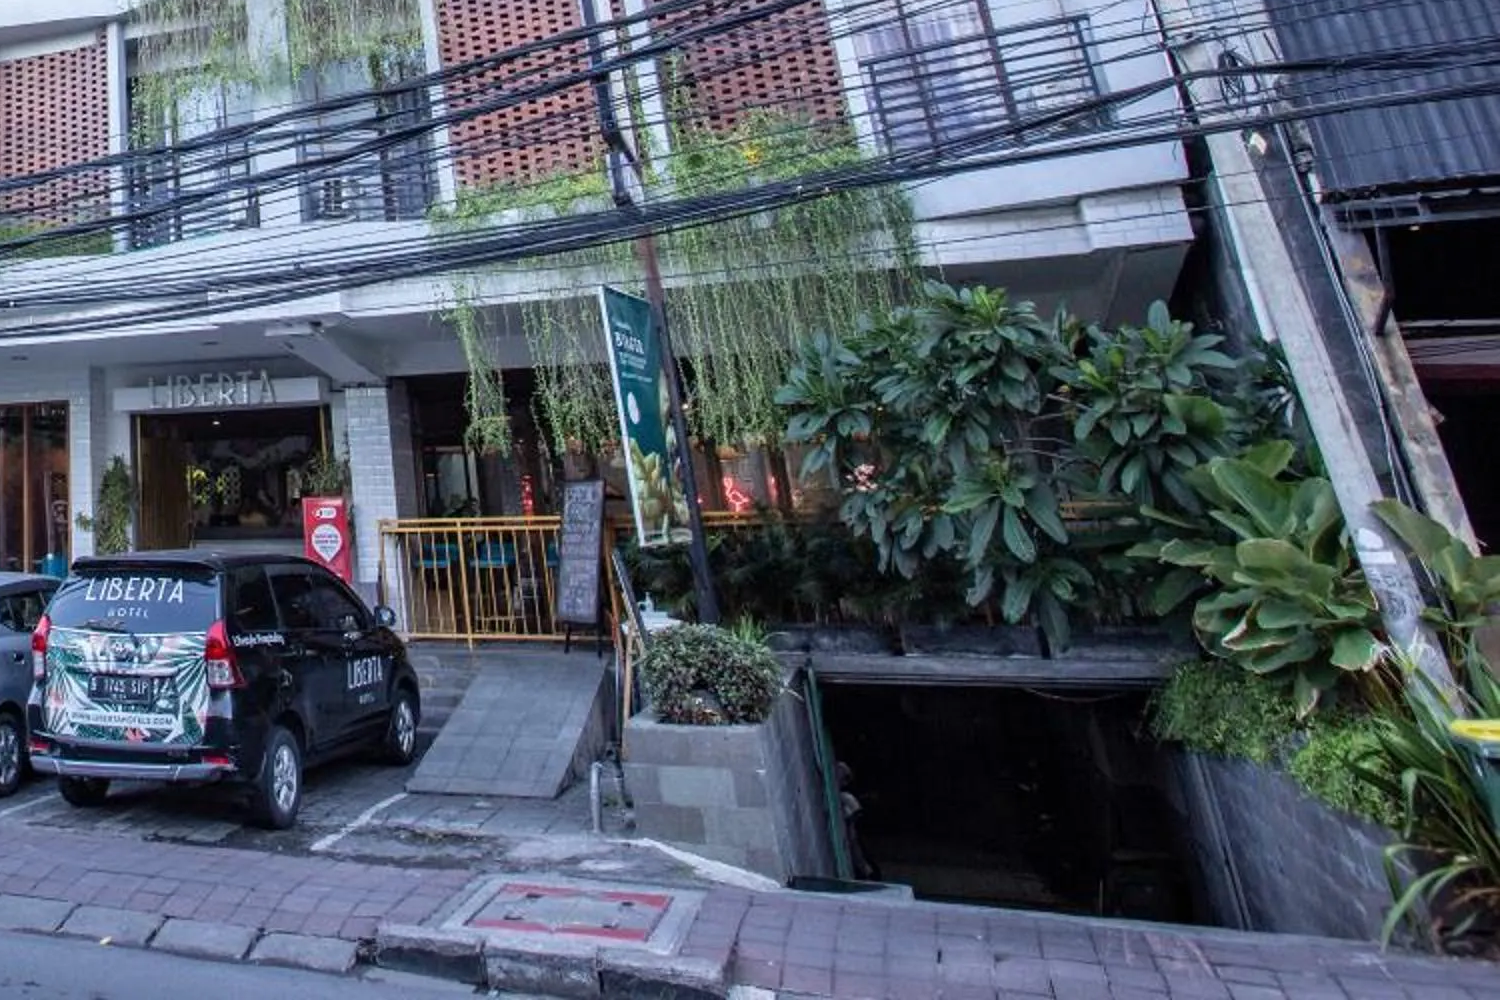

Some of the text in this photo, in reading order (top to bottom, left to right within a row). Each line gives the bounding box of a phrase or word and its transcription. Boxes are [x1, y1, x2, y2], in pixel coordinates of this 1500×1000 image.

[148, 368, 277, 410] LIBERTA
[85, 577, 184, 603] LIBERTA
[107, 606, 149, 619] HOTEL
[347, 655, 383, 689] LIBERTA
